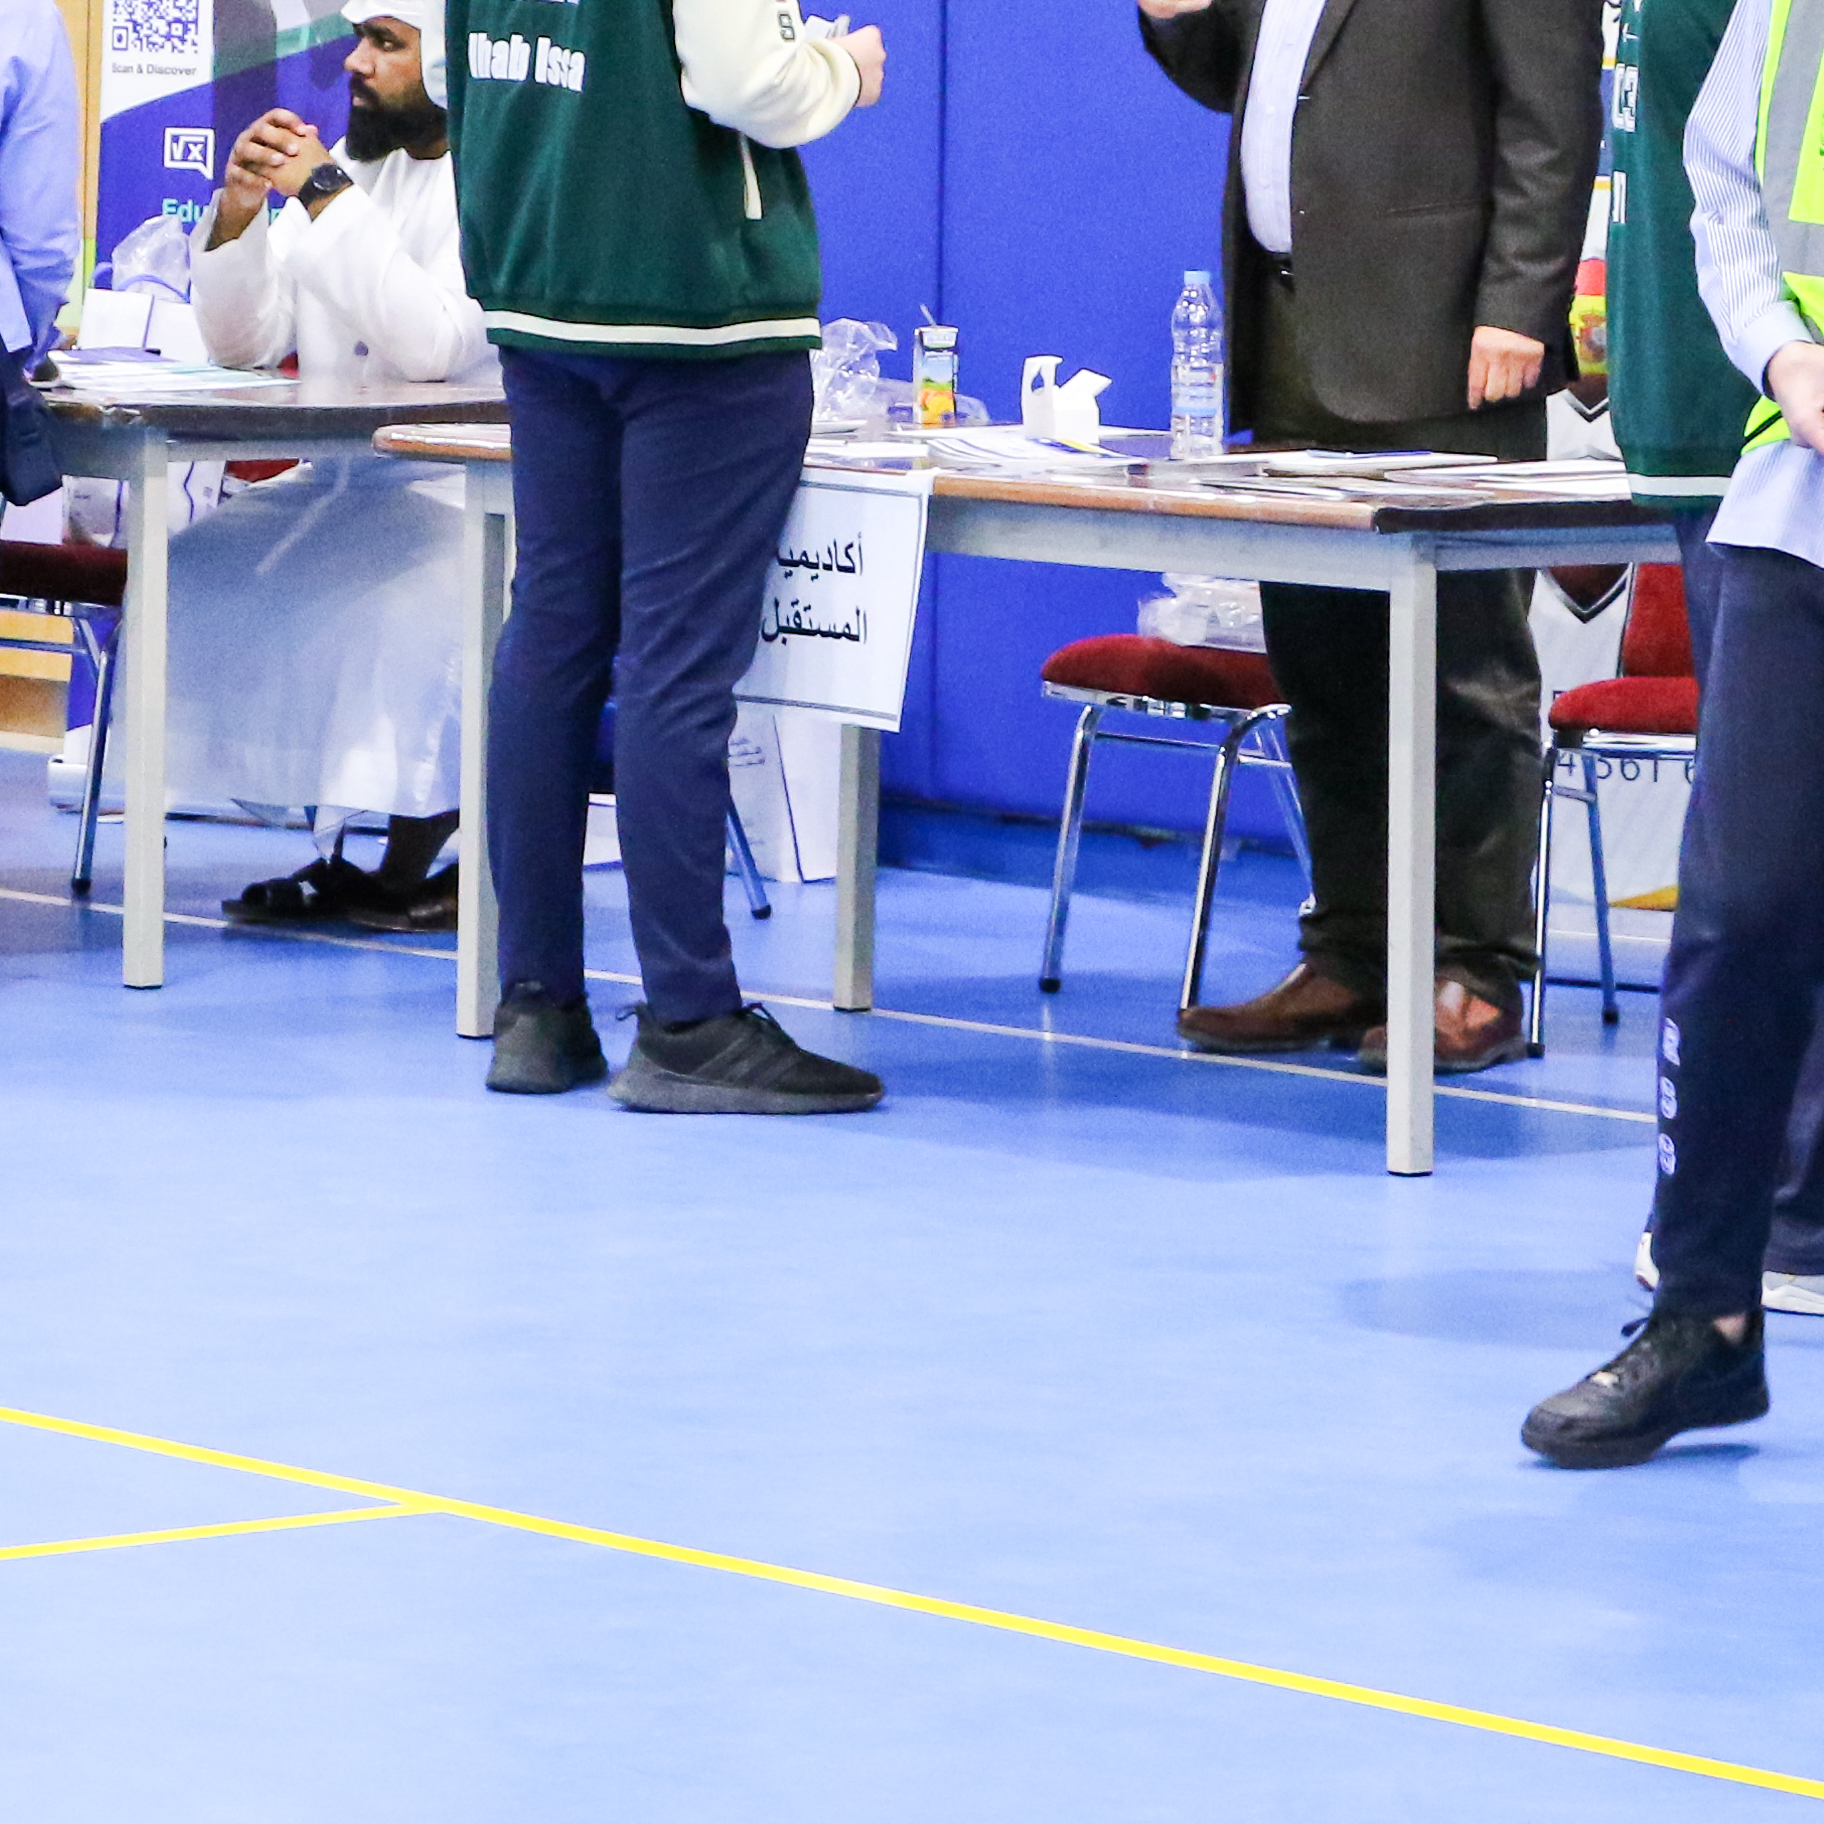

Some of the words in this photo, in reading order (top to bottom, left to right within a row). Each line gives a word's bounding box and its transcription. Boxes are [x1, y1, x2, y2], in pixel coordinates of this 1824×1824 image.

[111, 62, 134, 74] Scan
[136, 63, 144, 75] &
[146, 62, 197, 76] Discover
[776, 530, 864, 582] أكاديمي
[760, 596, 868, 646] المستقبل
